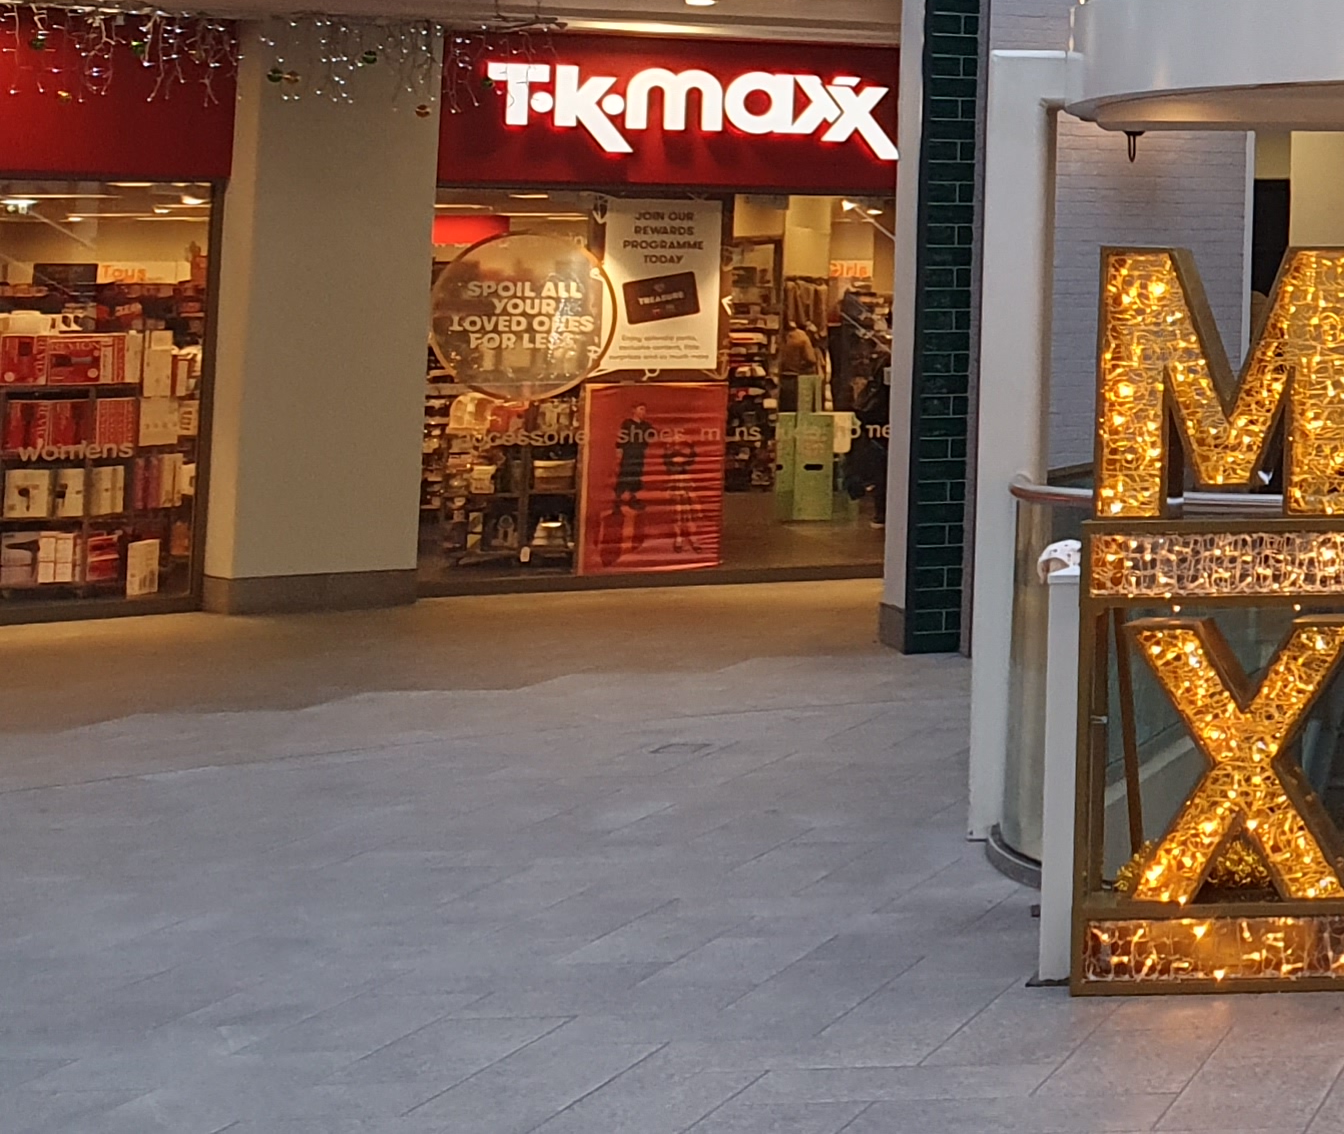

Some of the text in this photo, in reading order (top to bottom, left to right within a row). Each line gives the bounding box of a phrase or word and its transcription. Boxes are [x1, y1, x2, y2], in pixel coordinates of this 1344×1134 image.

[634, 211, 695, 222] JOIN OUR
[634, 225, 695, 236] REWARDS
[623, 240, 704, 250] PROGRAMME
[644, 254, 684, 264] TODAY
[467, 281, 583, 298] SPOIL ALL
[491, 298, 557, 314] YOUR
[449, 316, 527, 331] LOVED
[469, 333, 517, 349] FOR
[617, 425, 684, 443] shoes
[701, 427, 762, 442] mns
[18, 443, 134, 461] womens
